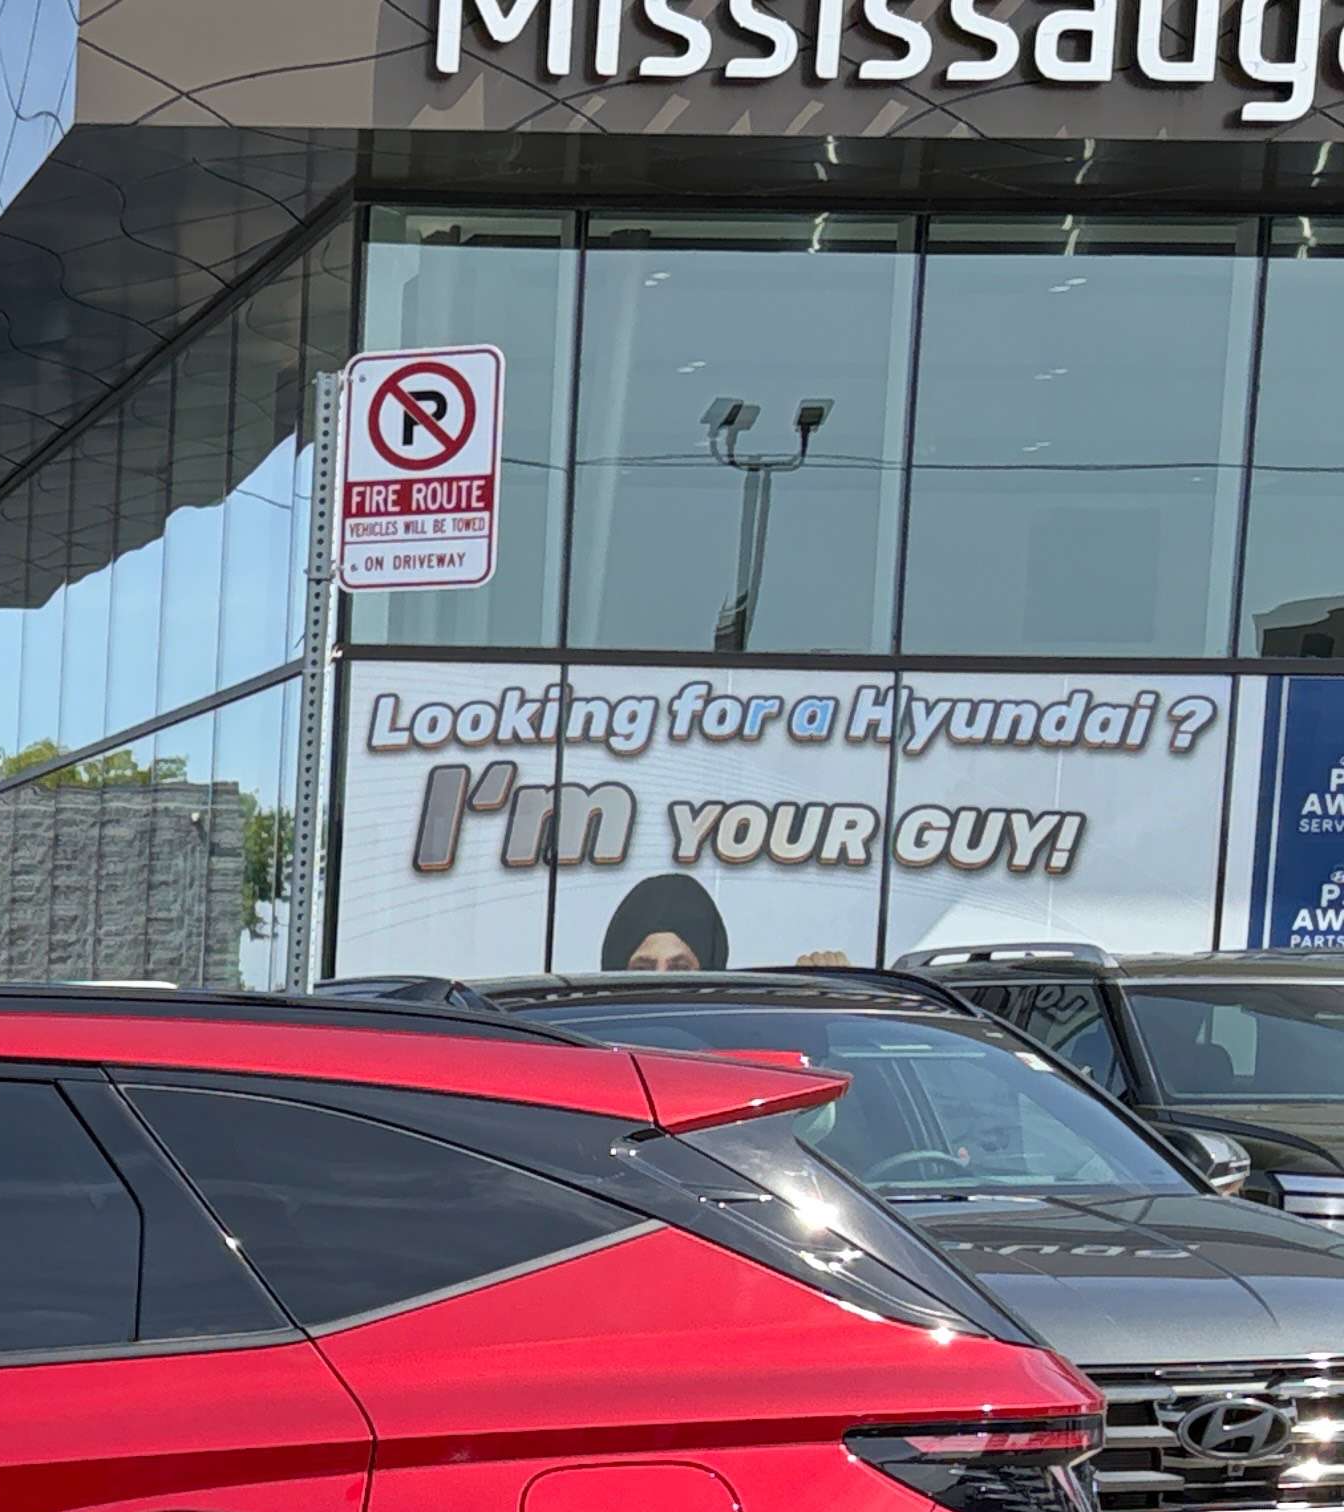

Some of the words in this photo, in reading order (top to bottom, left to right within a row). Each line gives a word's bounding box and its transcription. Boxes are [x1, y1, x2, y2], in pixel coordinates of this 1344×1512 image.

[435, 0, 1344, 121] Mississaug
[351, 484, 401, 514] FIRE
[411, 480, 485, 511] ROUTE
[349, 520, 399, 538] VEHICLES
[403, 519, 427, 536] WILL
[432, 518, 446, 534] BE
[452, 517, 485, 532] TOWED
[364, 556, 385, 572] ON
[393, 552, 466, 571] DRIVEWAY
[368, 683, 659, 756] Looking
[669, 681, 784, 743] for
[789, 696, 838, 743] a
[845, 684, 1160, 755] Hyundai
[412, 760, 637, 873] I'm
[668, 803, 880, 865] YOUR
[892, 805, 1087, 875] GUY!
